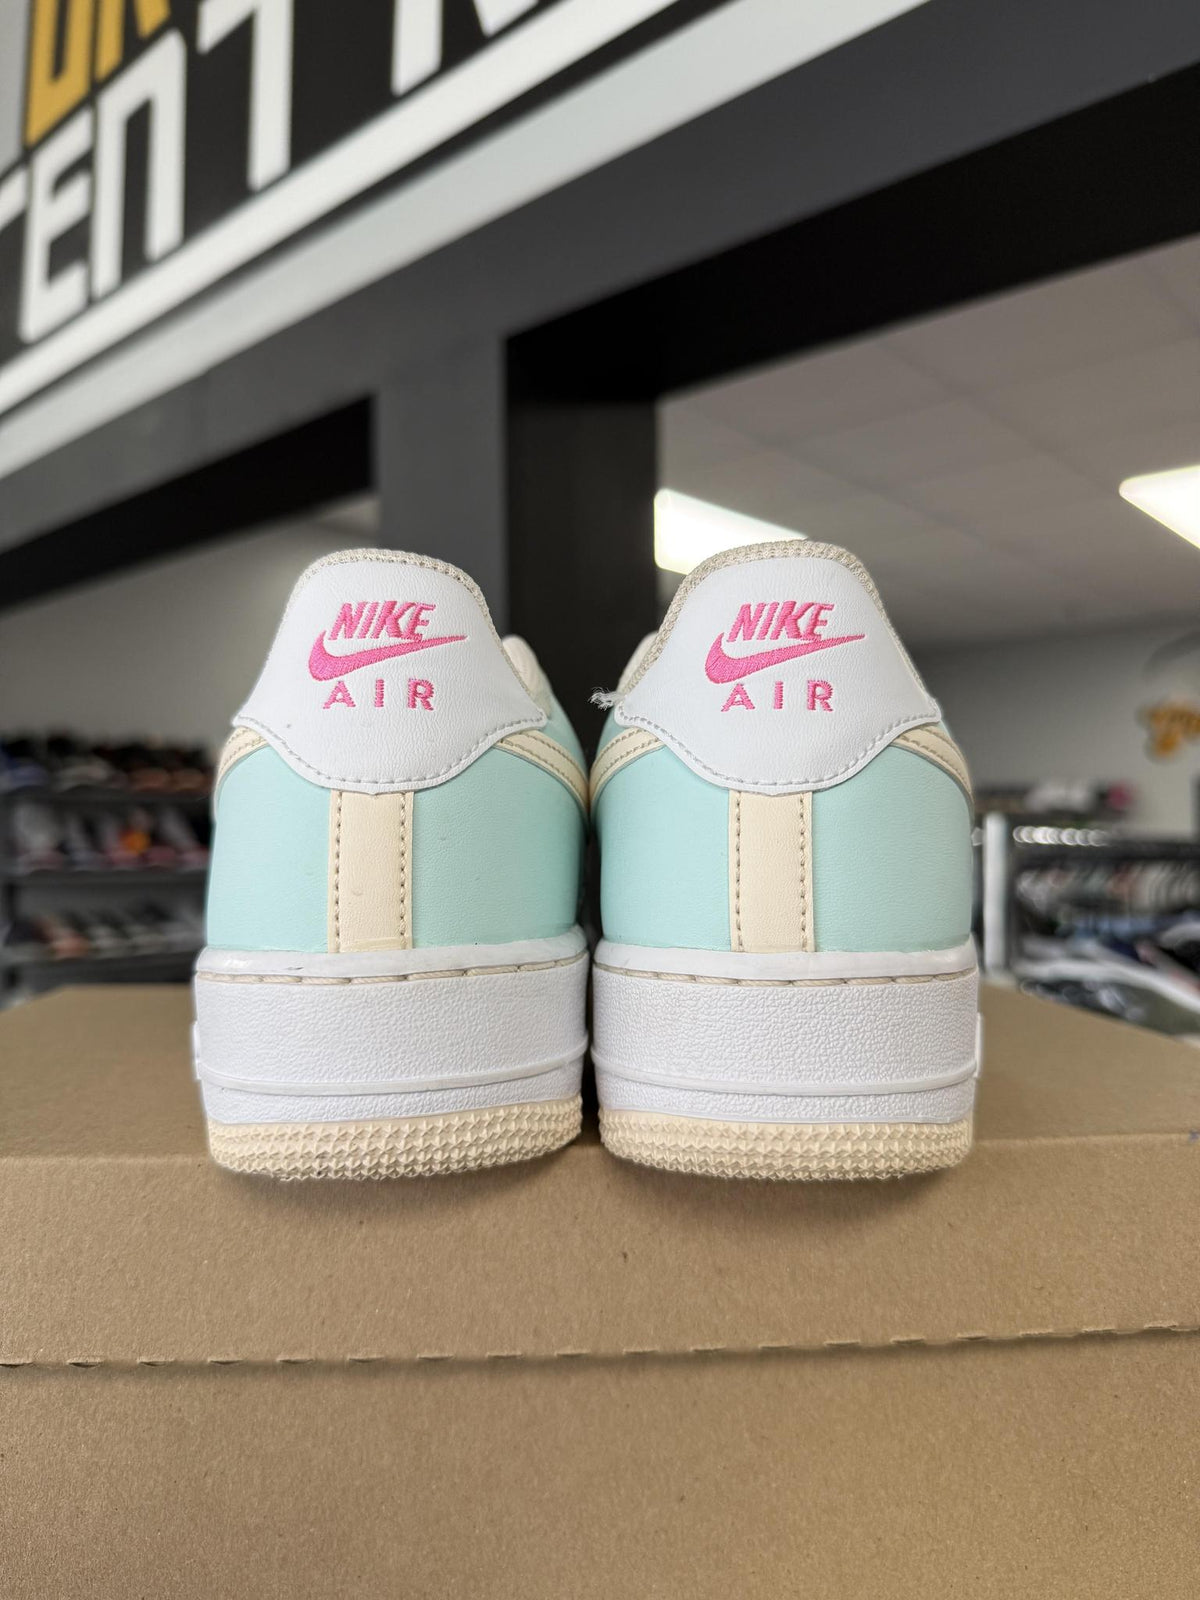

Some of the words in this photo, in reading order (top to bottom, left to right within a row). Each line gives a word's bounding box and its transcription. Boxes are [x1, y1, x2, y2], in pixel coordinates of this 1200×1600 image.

[328, 600, 436, 642] NIKE
[726, 600, 835, 642] NIKE
[323, 678, 434, 711] AIR
[720, 680, 833, 712] AIR
